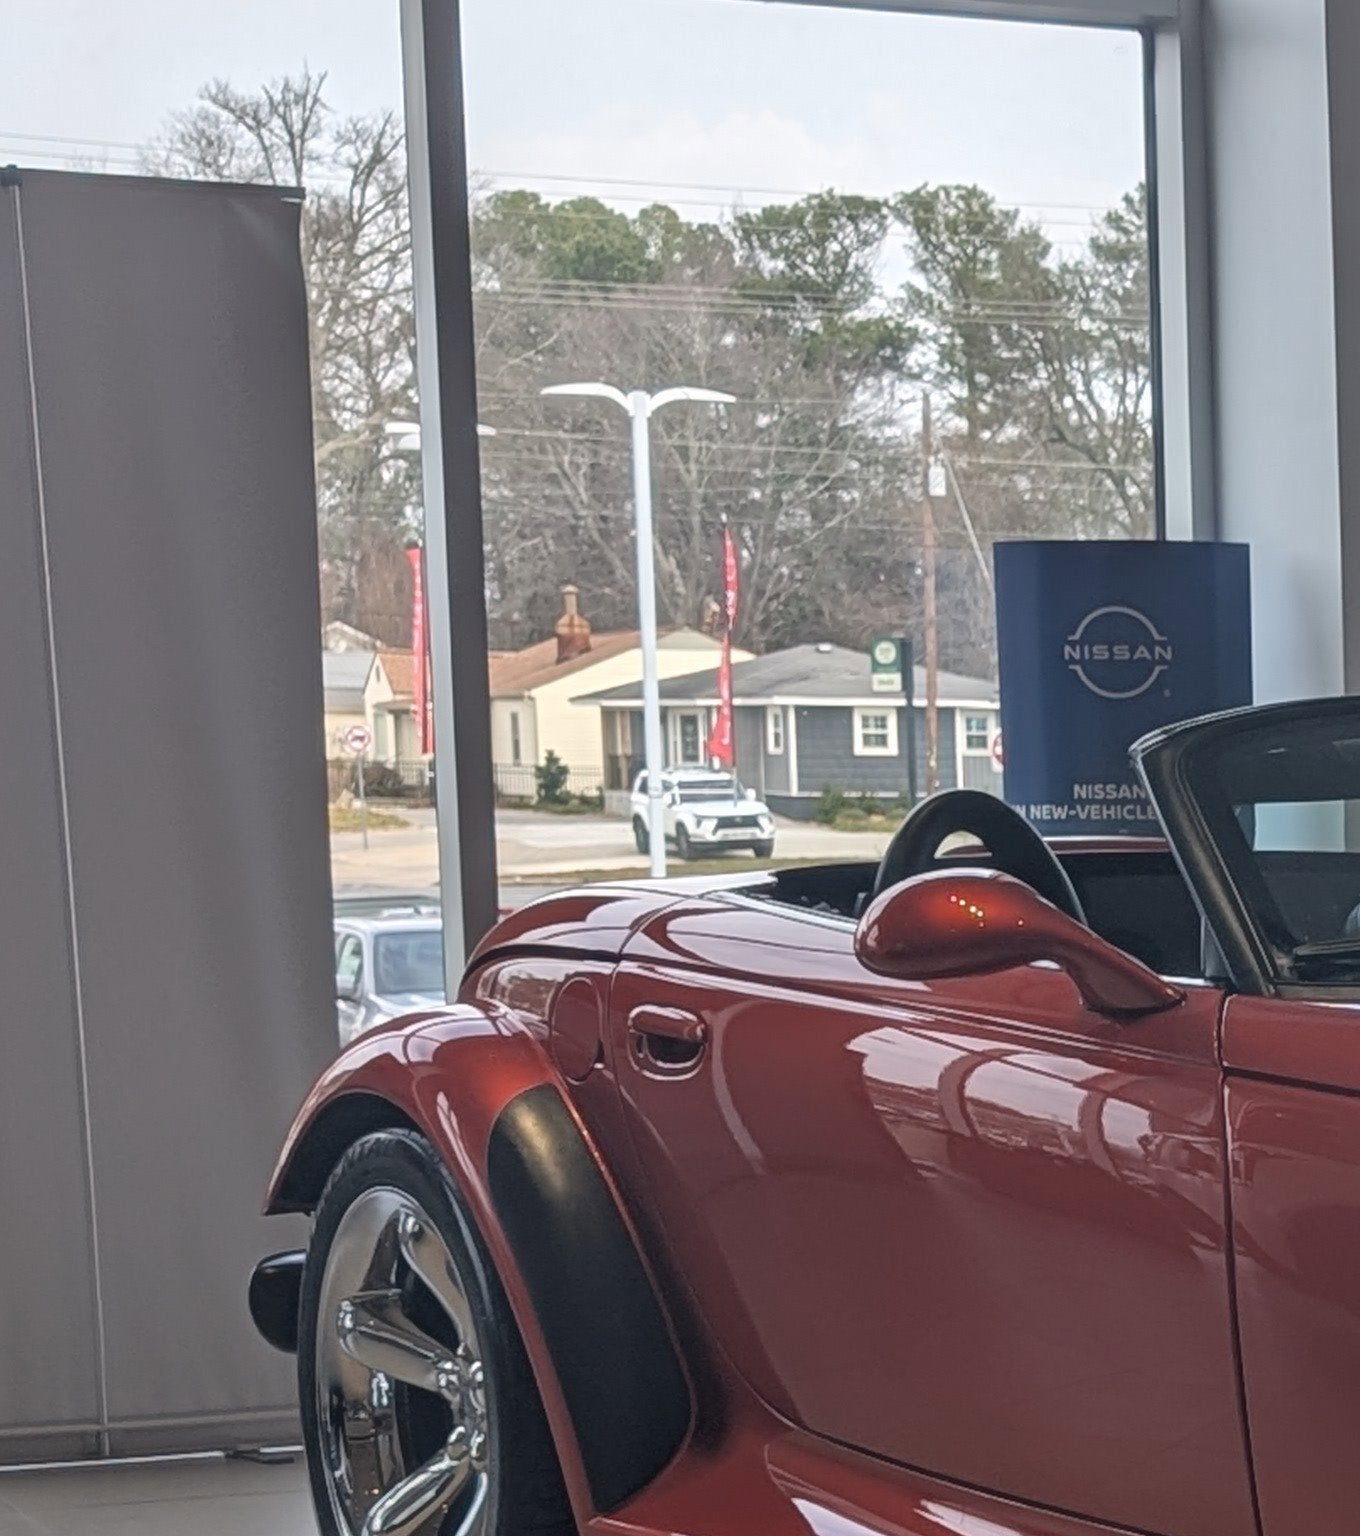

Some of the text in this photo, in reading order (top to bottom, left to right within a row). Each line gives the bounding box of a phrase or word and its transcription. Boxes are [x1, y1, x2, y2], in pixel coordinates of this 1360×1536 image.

[1064, 644, 1173, 662] NISSAN
[1073, 784, 1147, 799] NISSAN
[1030, 804, 1156, 820] NEW-VEHICLE
